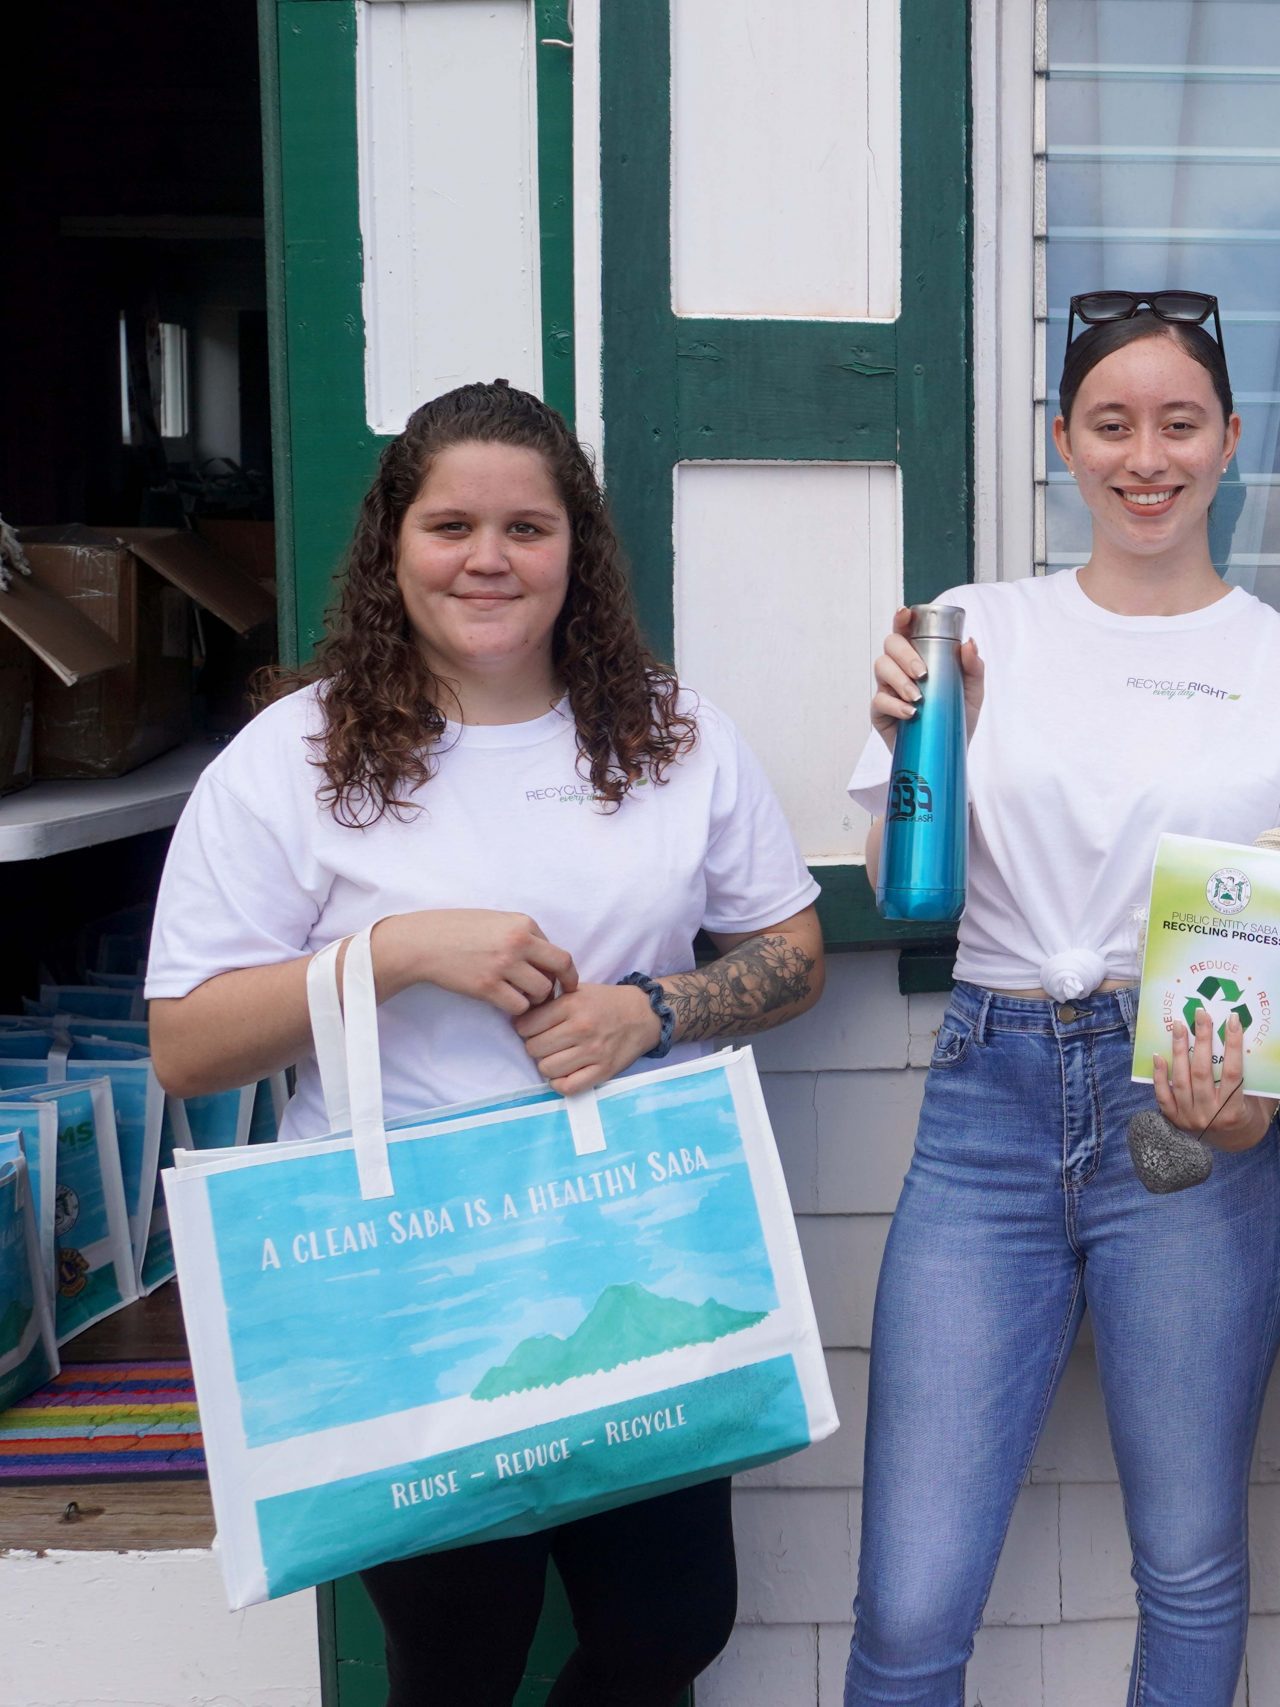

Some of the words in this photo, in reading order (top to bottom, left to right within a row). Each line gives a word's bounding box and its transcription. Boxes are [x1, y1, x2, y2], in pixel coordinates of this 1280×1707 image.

[1127, 678, 1185, 690] RECYCLE
[1188, 682, 1228, 700] RIGHT
[525, 785, 589, 801] RECYCLE
[1163, 921, 1228, 938] RECYCLING
[1172, 911, 1210, 925] PUBLIC
[1212, 917, 1249, 931] ENTITY
[1250, 924, 1279, 936] SABA
[1190, 960, 1240, 974] REDUCE
[1163, 991, 1176, 1032] REUSE
[1253, 991, 1271, 1047] RECYCLE
[260, 1238, 281, 1271] A
[292, 1220, 378, 1264] CLEAN
[389, 1210, 455, 1245] SABA
[463, 1199, 491, 1230] IS
[503, 1194, 519, 1221] A
[528, 1162, 638, 1214] HEALTHY
[648, 1145, 709, 1183] SABA
[390, 1470, 461, 1509] REUSE
[495, 1438, 572, 1479] REDUCE
[605, 1404, 688, 1446] RECYCLE
